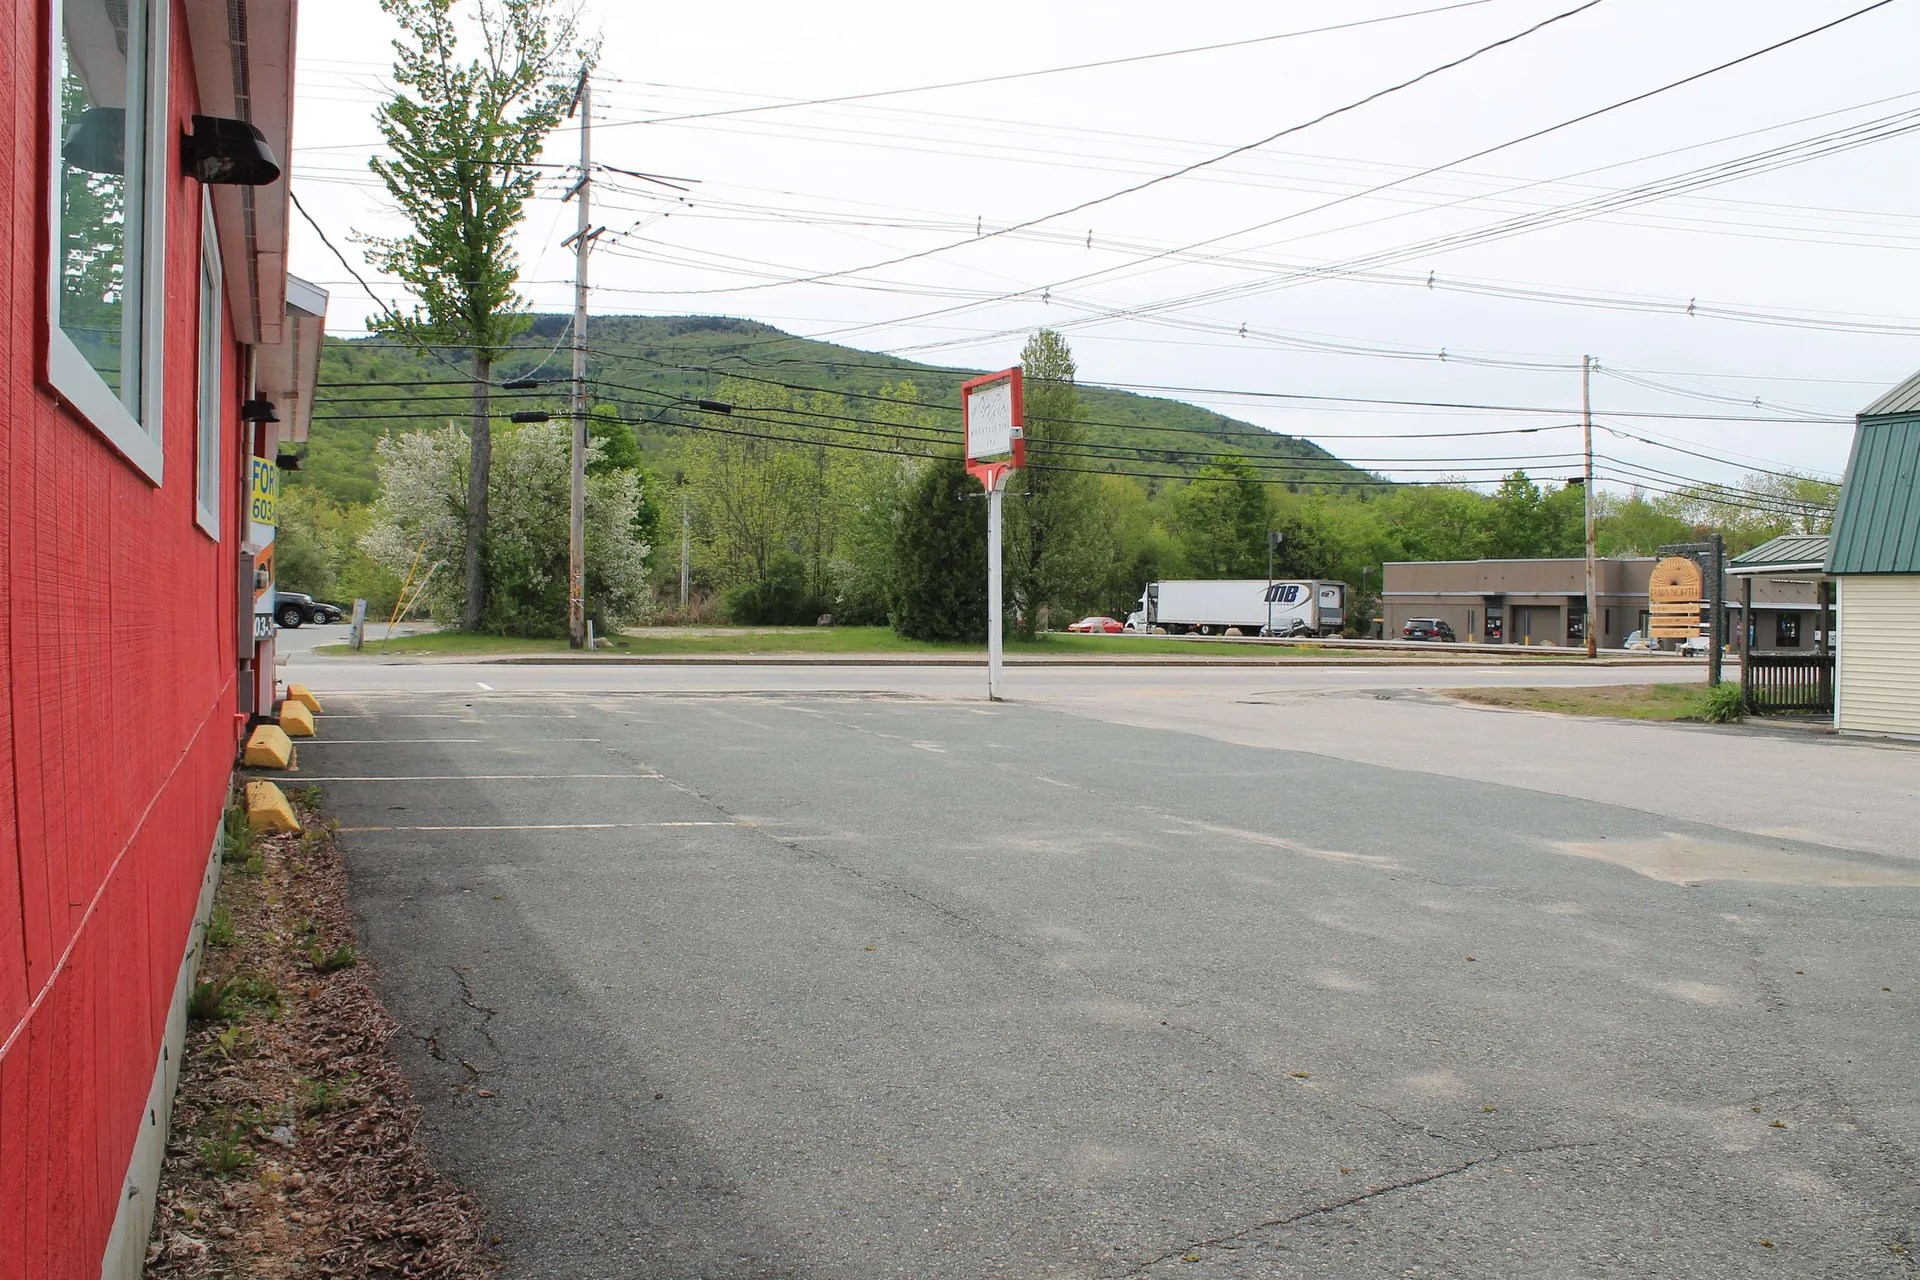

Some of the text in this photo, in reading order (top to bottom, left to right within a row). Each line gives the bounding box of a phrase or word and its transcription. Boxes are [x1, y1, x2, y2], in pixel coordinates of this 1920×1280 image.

[987, 440, 995, 448] SPA
[252, 460, 274, 495] FOR
[1671, 588, 1698, 597] NORTH
